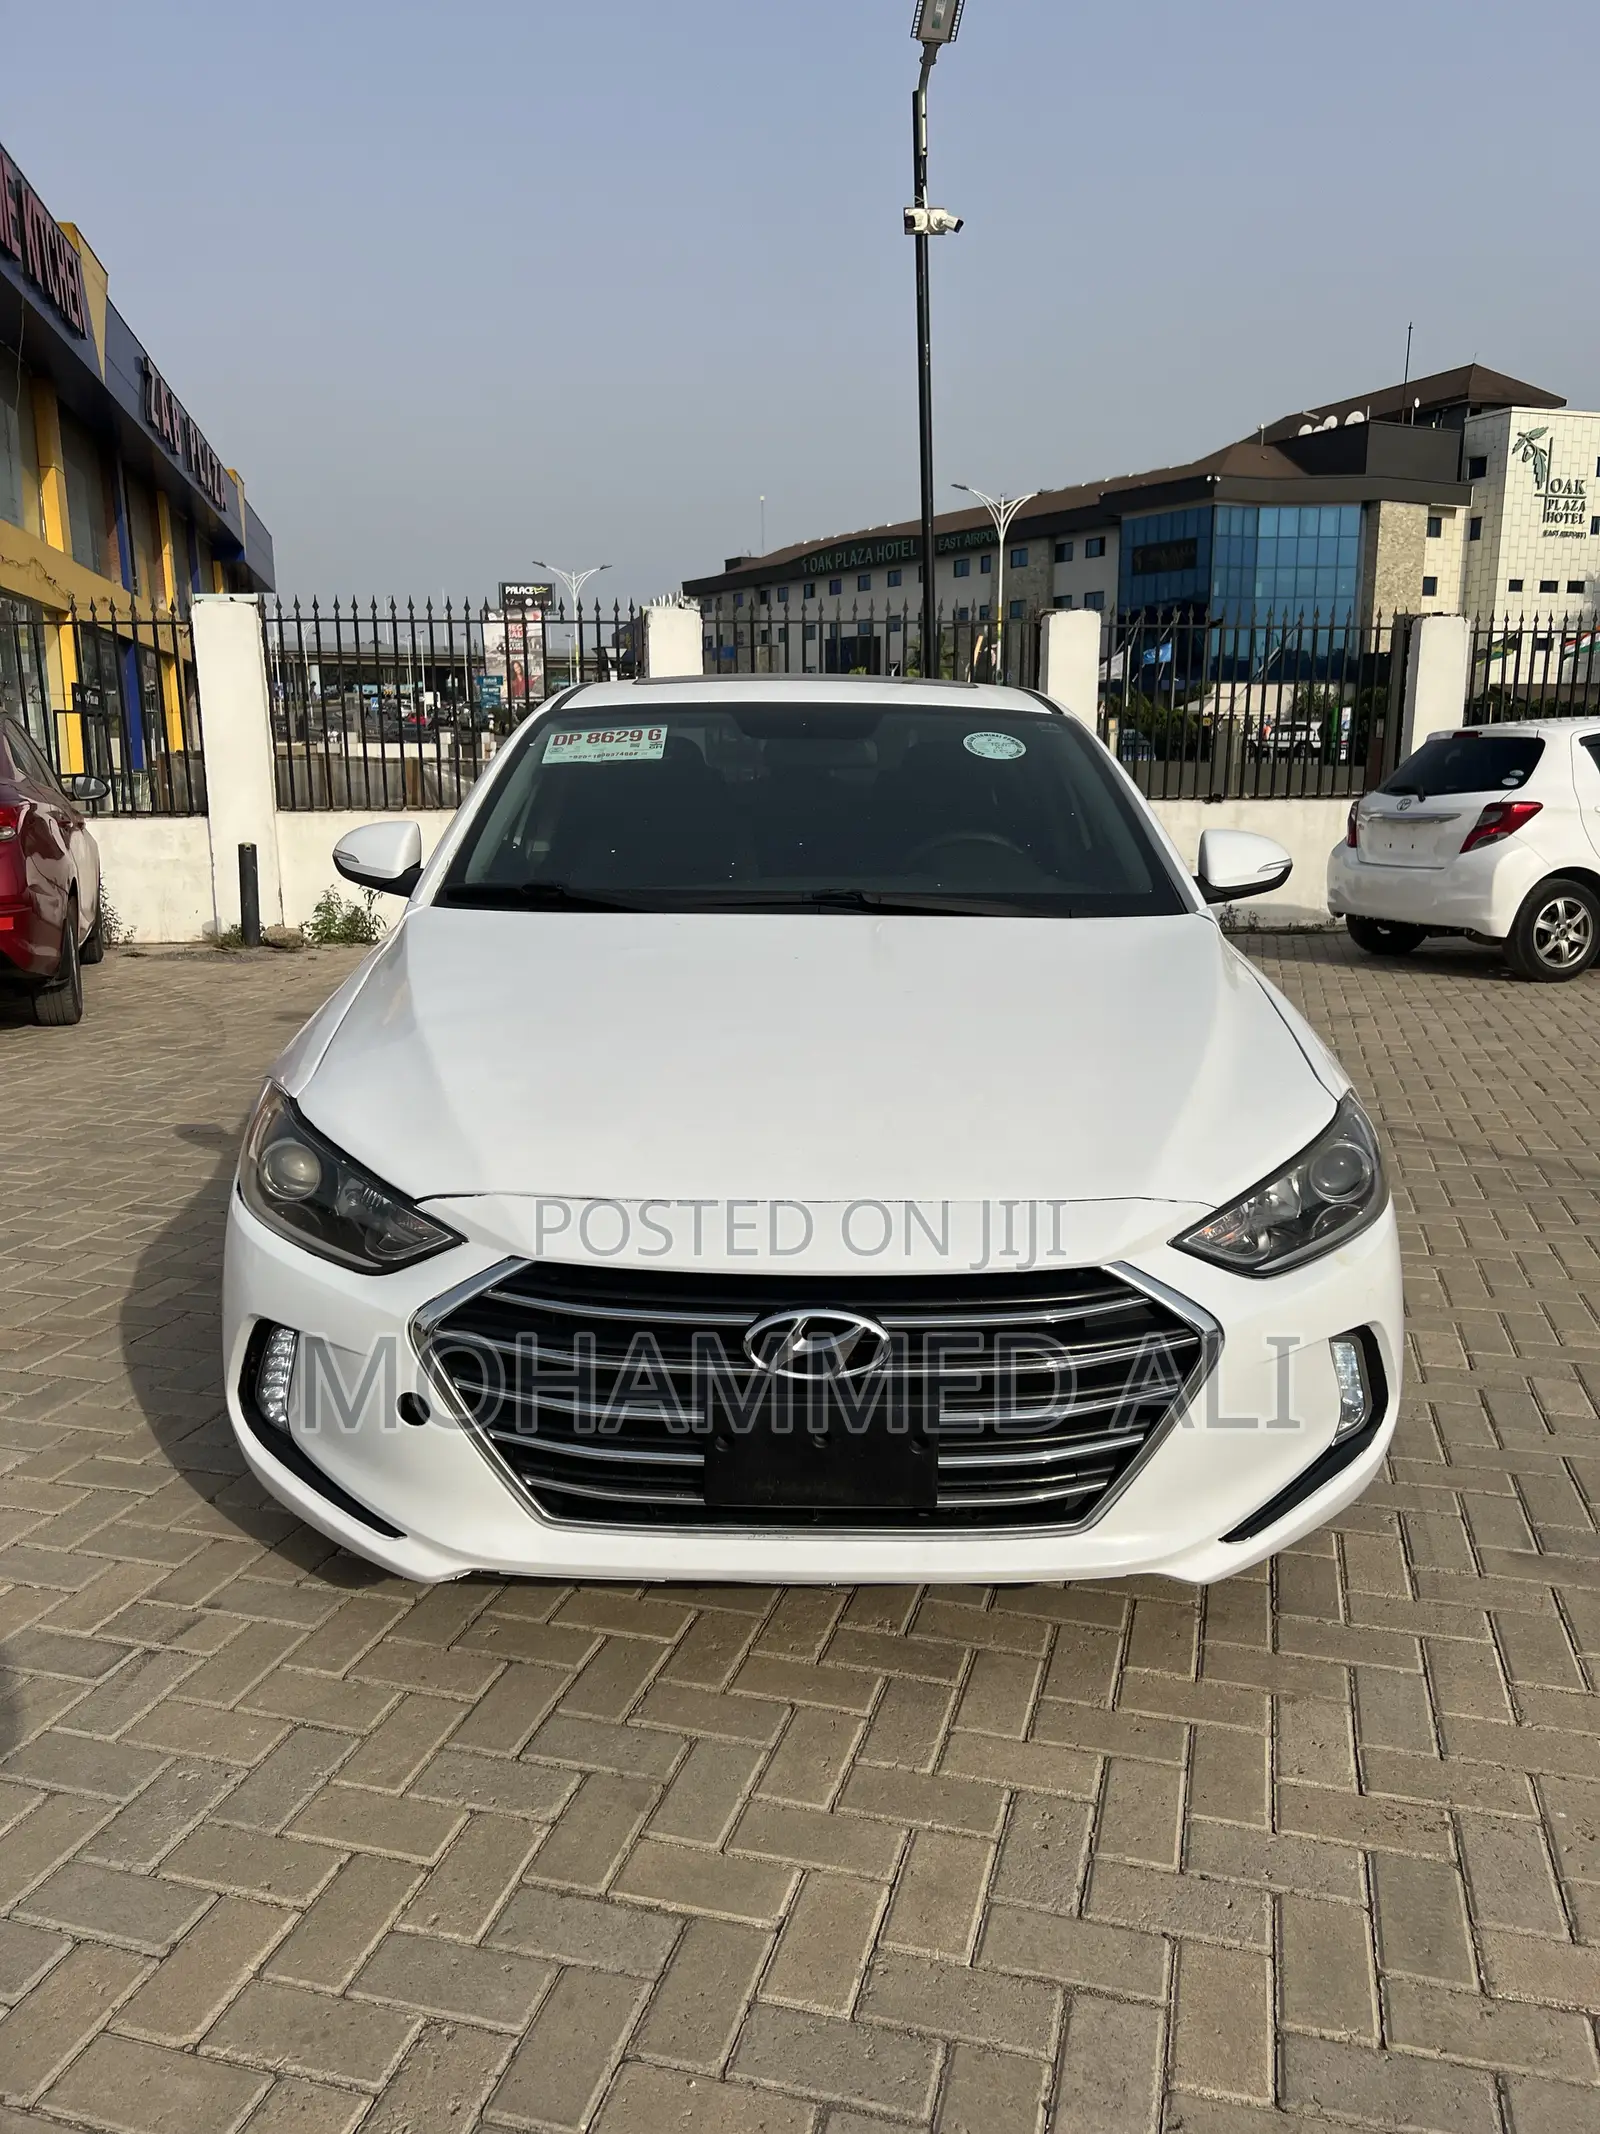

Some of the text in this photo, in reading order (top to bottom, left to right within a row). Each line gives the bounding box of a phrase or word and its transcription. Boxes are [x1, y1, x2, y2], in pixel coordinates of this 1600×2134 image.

[23, 186, 87, 339] KITCHEN
[187, 416, 227, 512] PLAZA
[1550, 478, 1587, 495] OAK
[1547, 499, 1586, 512] PLAZA
[1546, 512, 1586, 524] HOTEL
[810, 553, 833, 573] OAK
[836, 547, 873, 569] PLAZA
[876, 539, 917, 562] HOTEL
[938, 537, 962, 552] EAST
[964, 530, 1000, 547] AIRPOR
[505, 586, 534, 595] PALACE
[553, 729, 662, 746] DP 8629 G
